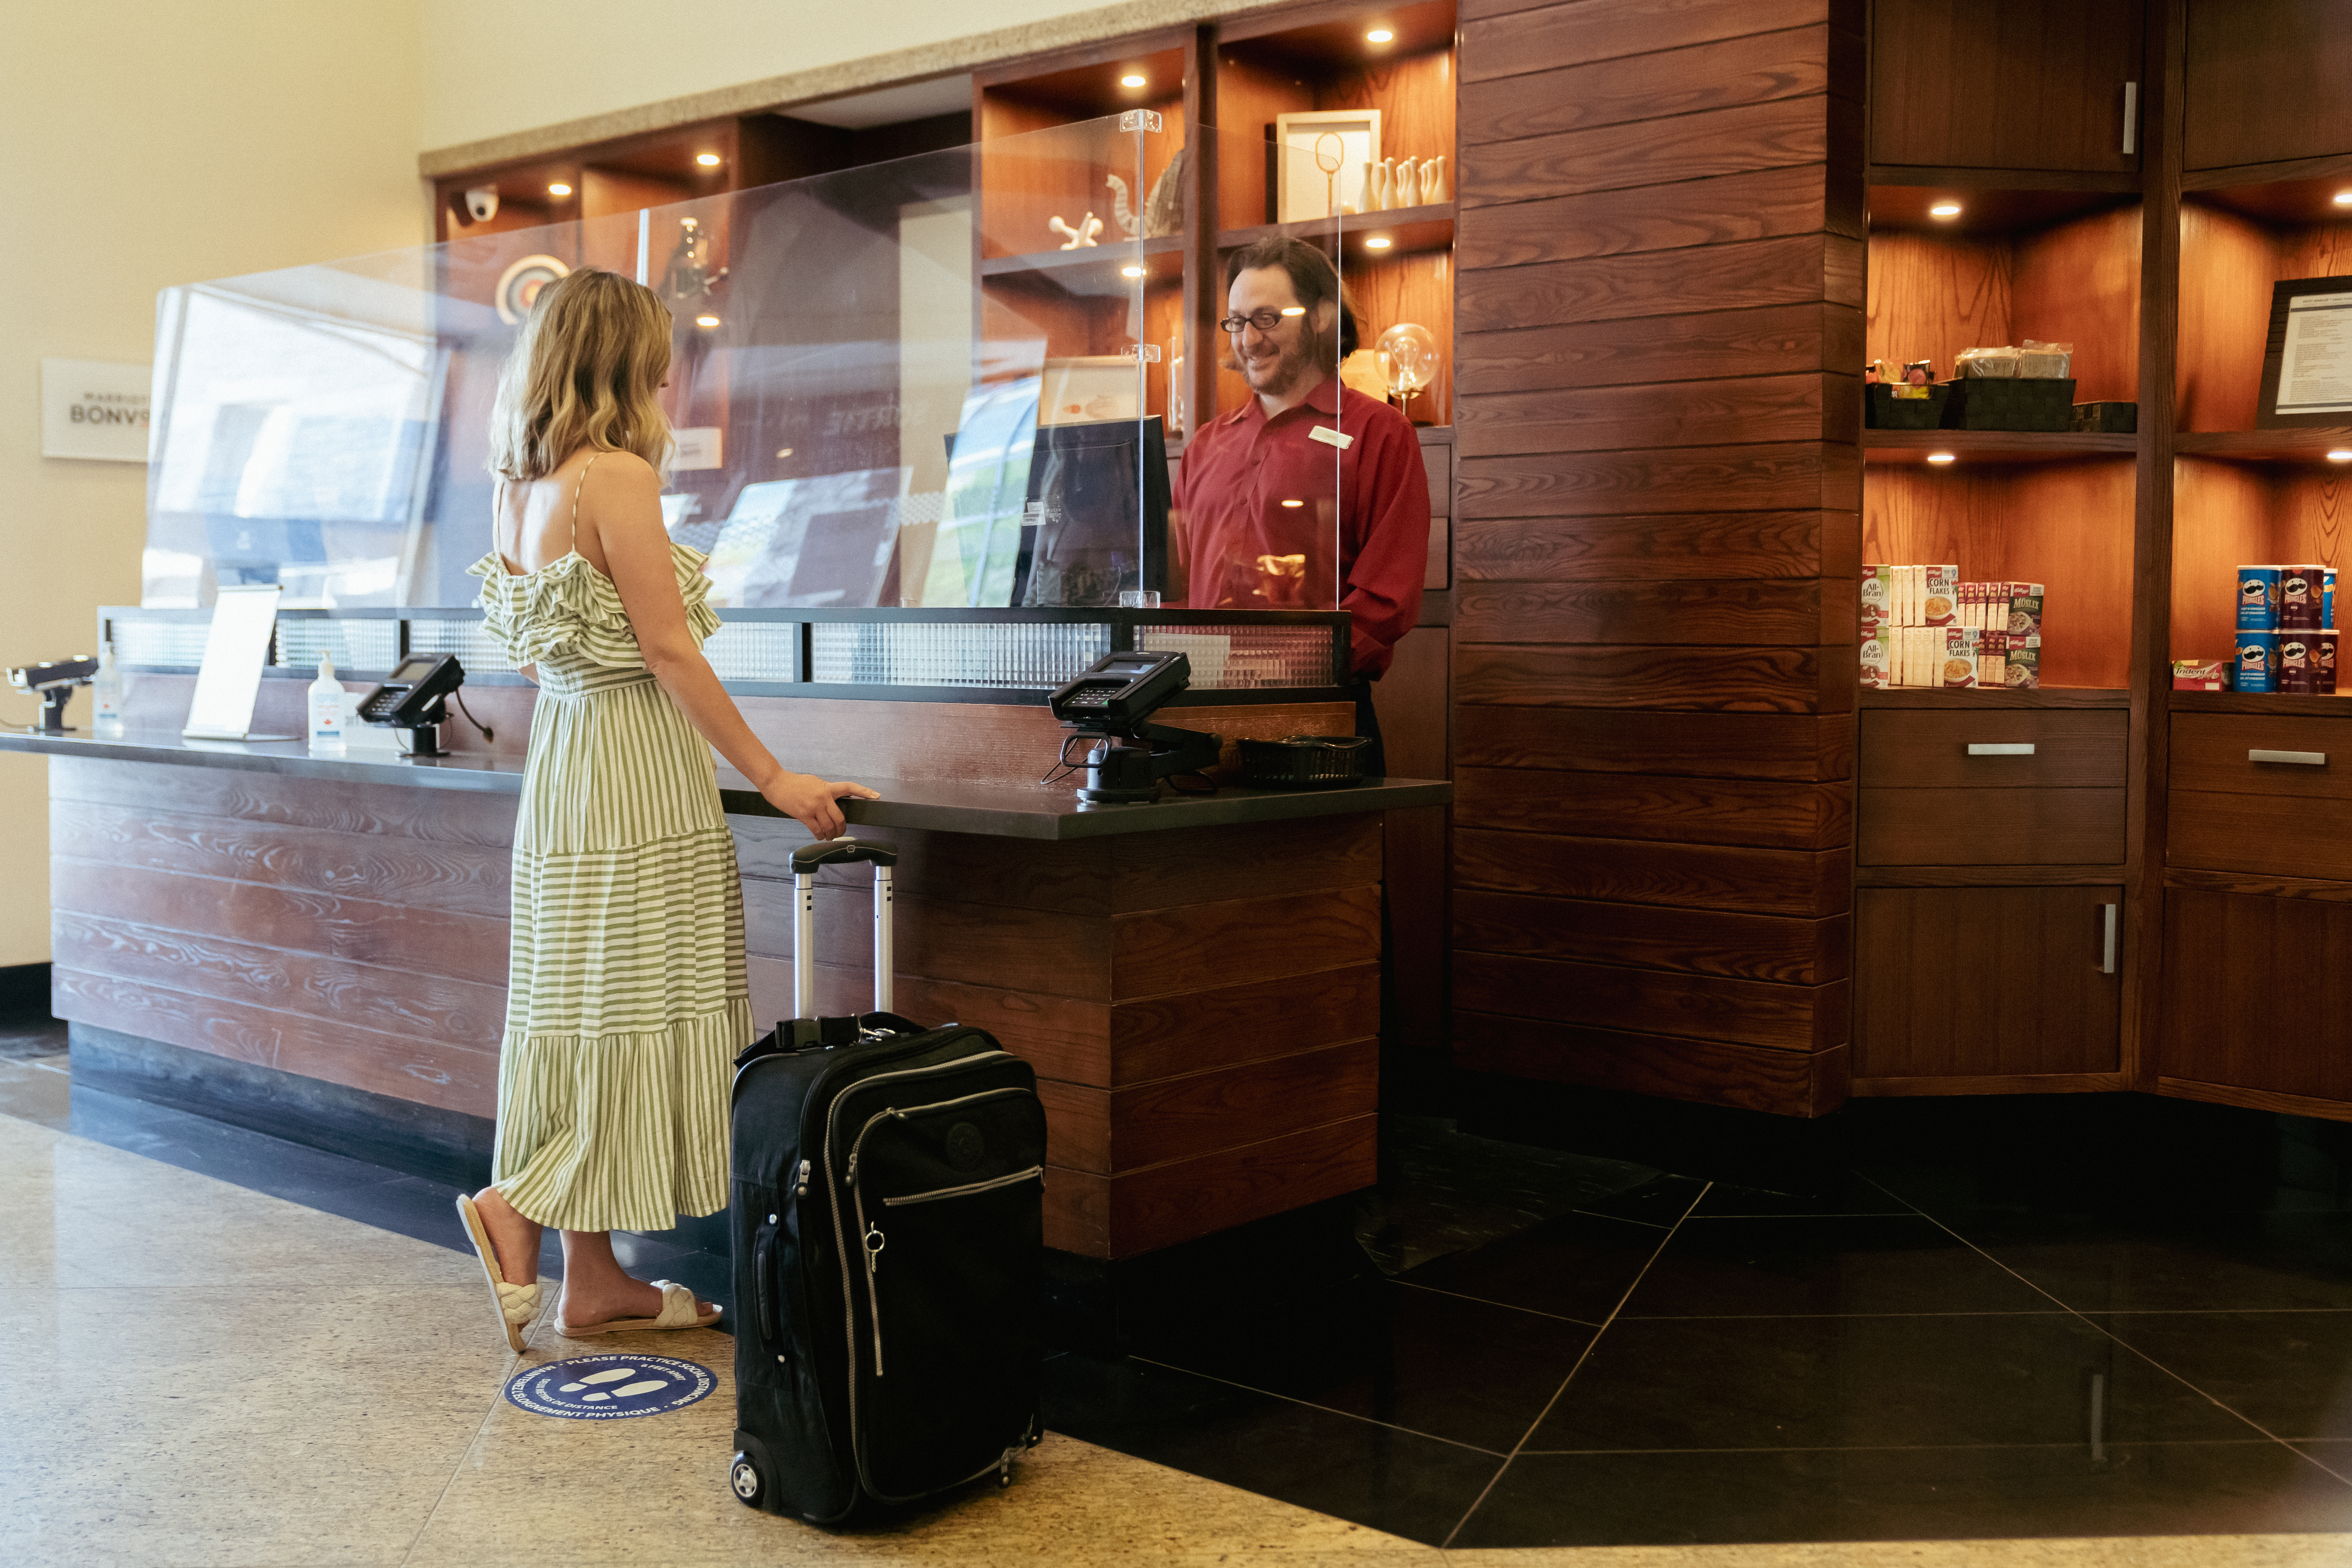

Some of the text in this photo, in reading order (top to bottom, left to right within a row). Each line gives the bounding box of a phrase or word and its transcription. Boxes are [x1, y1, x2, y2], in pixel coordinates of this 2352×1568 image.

[536, 1378, 552, 1389] DEUX
[566, 1356, 710, 1405] PLEASE PRACTICE SOCIAL DISTANCING
[666, 1370, 686, 1381] APART
[511, 1365, 557, 1391] MAINTENEZ
[585, 1406, 661, 1417] PHYSIQUE
